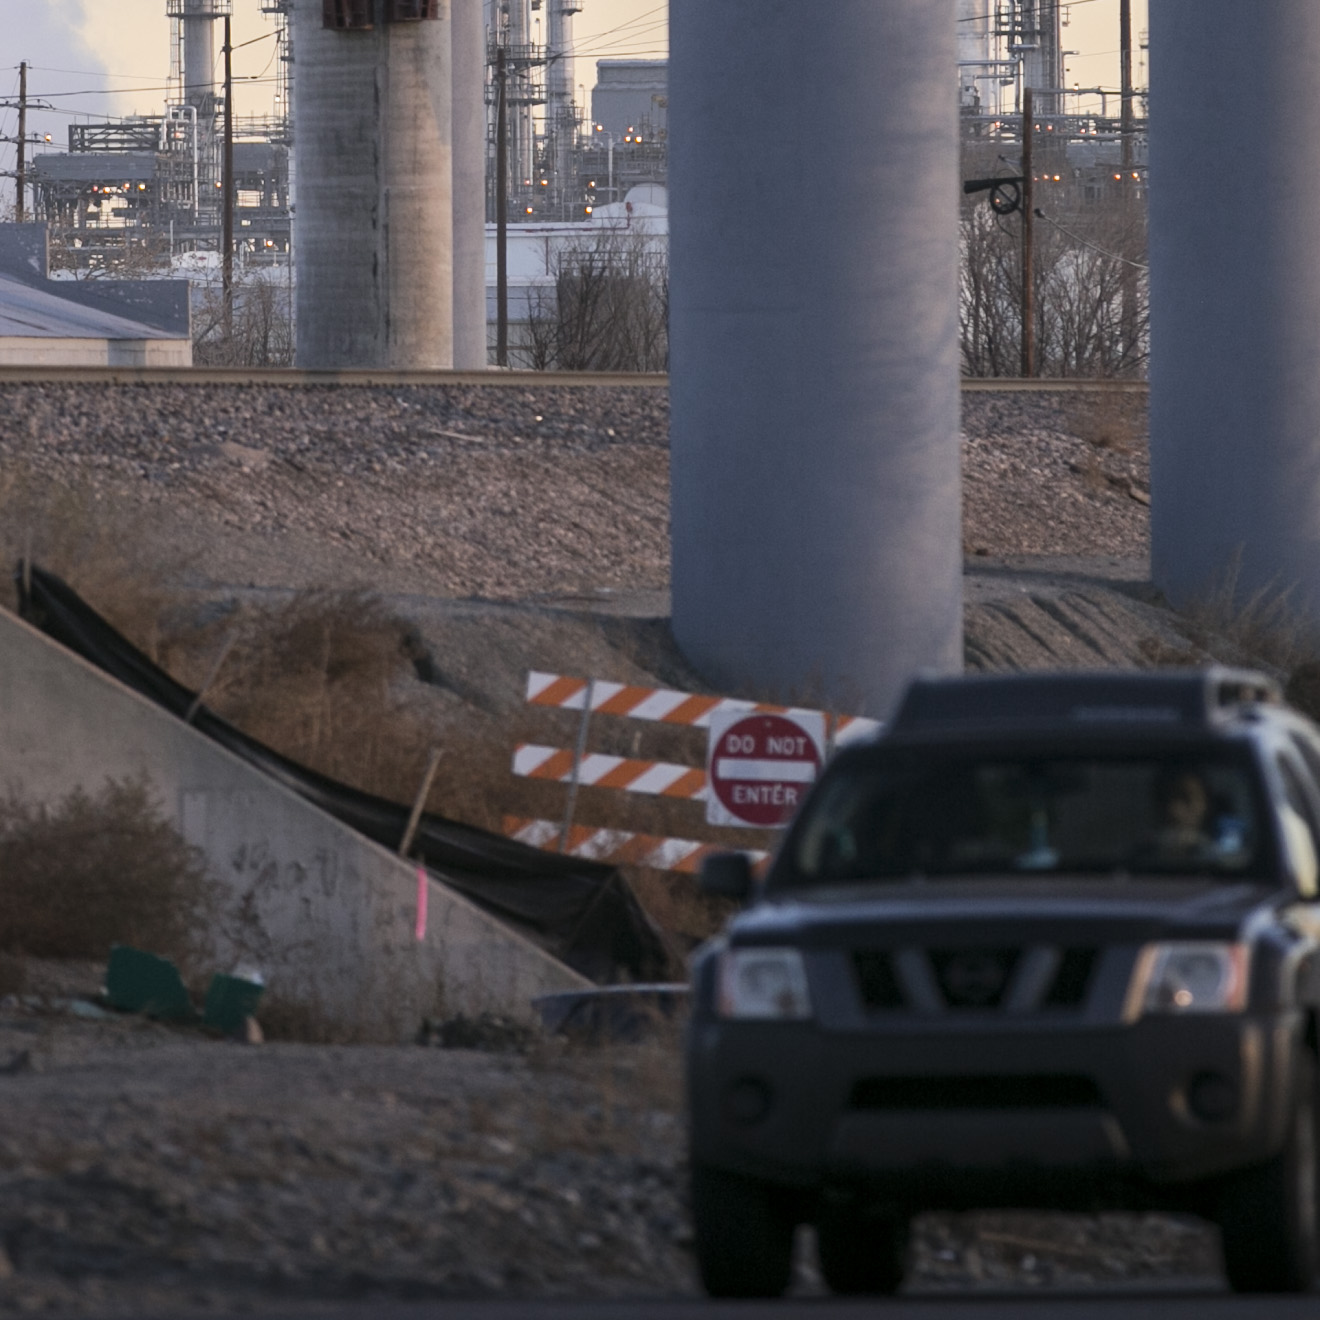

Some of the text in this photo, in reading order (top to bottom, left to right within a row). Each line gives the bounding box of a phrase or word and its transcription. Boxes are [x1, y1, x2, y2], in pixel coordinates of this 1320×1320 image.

[726, 734, 807, 756] DO NOT
[733, 784, 798, 806] ENTER
